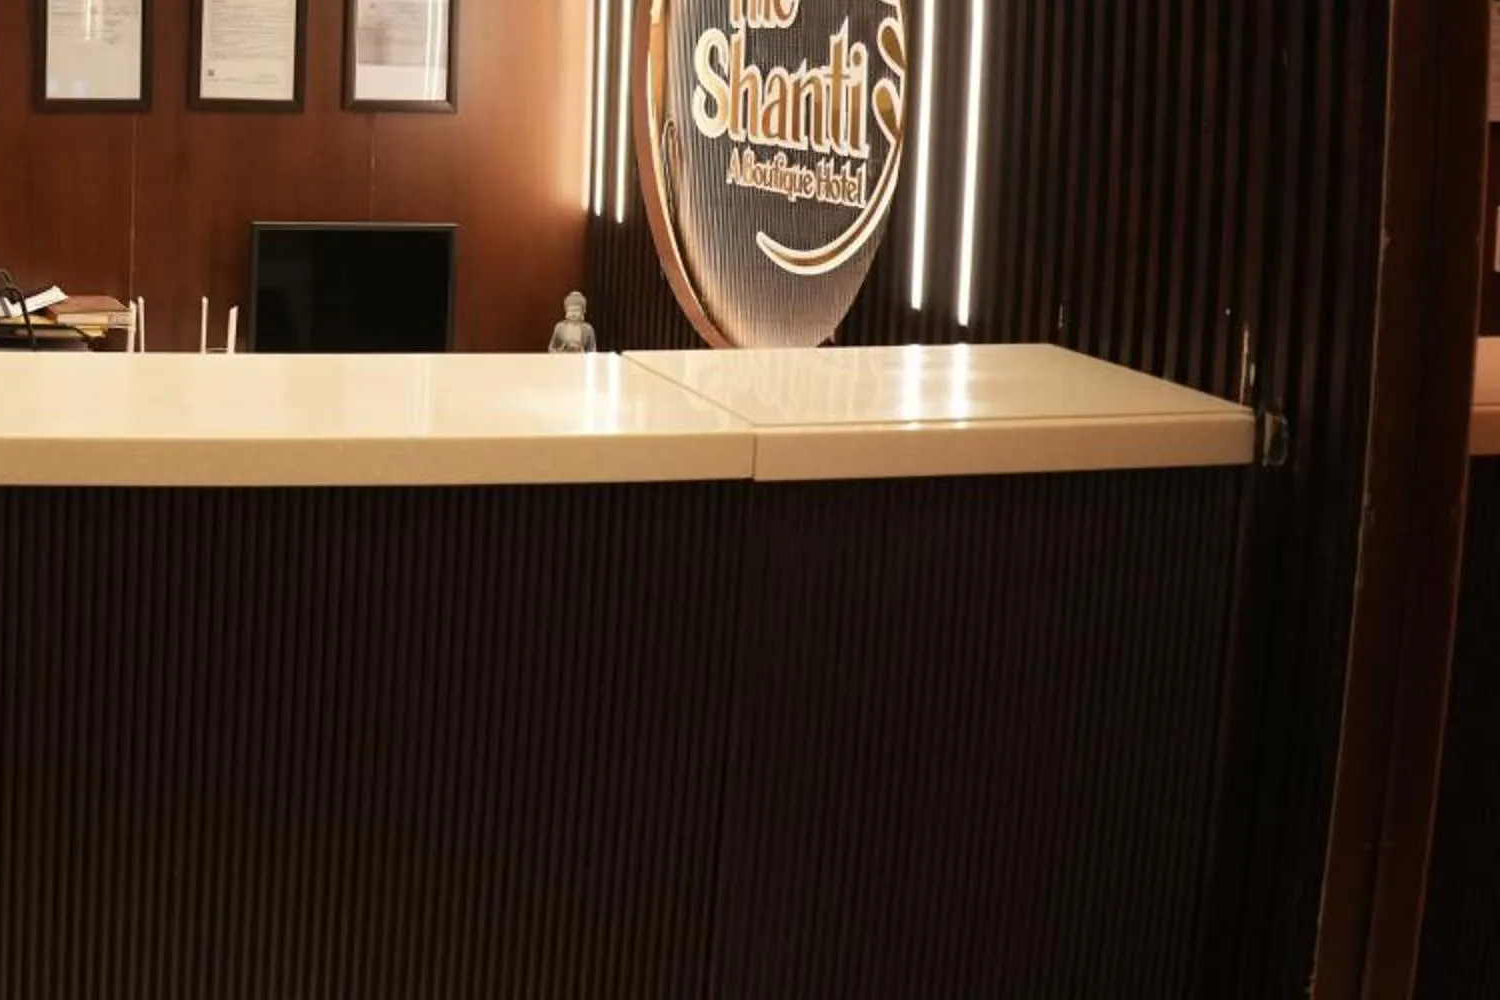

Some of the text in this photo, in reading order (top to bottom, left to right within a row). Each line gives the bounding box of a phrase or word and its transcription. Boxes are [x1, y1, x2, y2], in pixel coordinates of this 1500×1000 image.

[693, 18, 869, 158] Shanti
[726, 147, 867, 209] A Boutique Hotel
